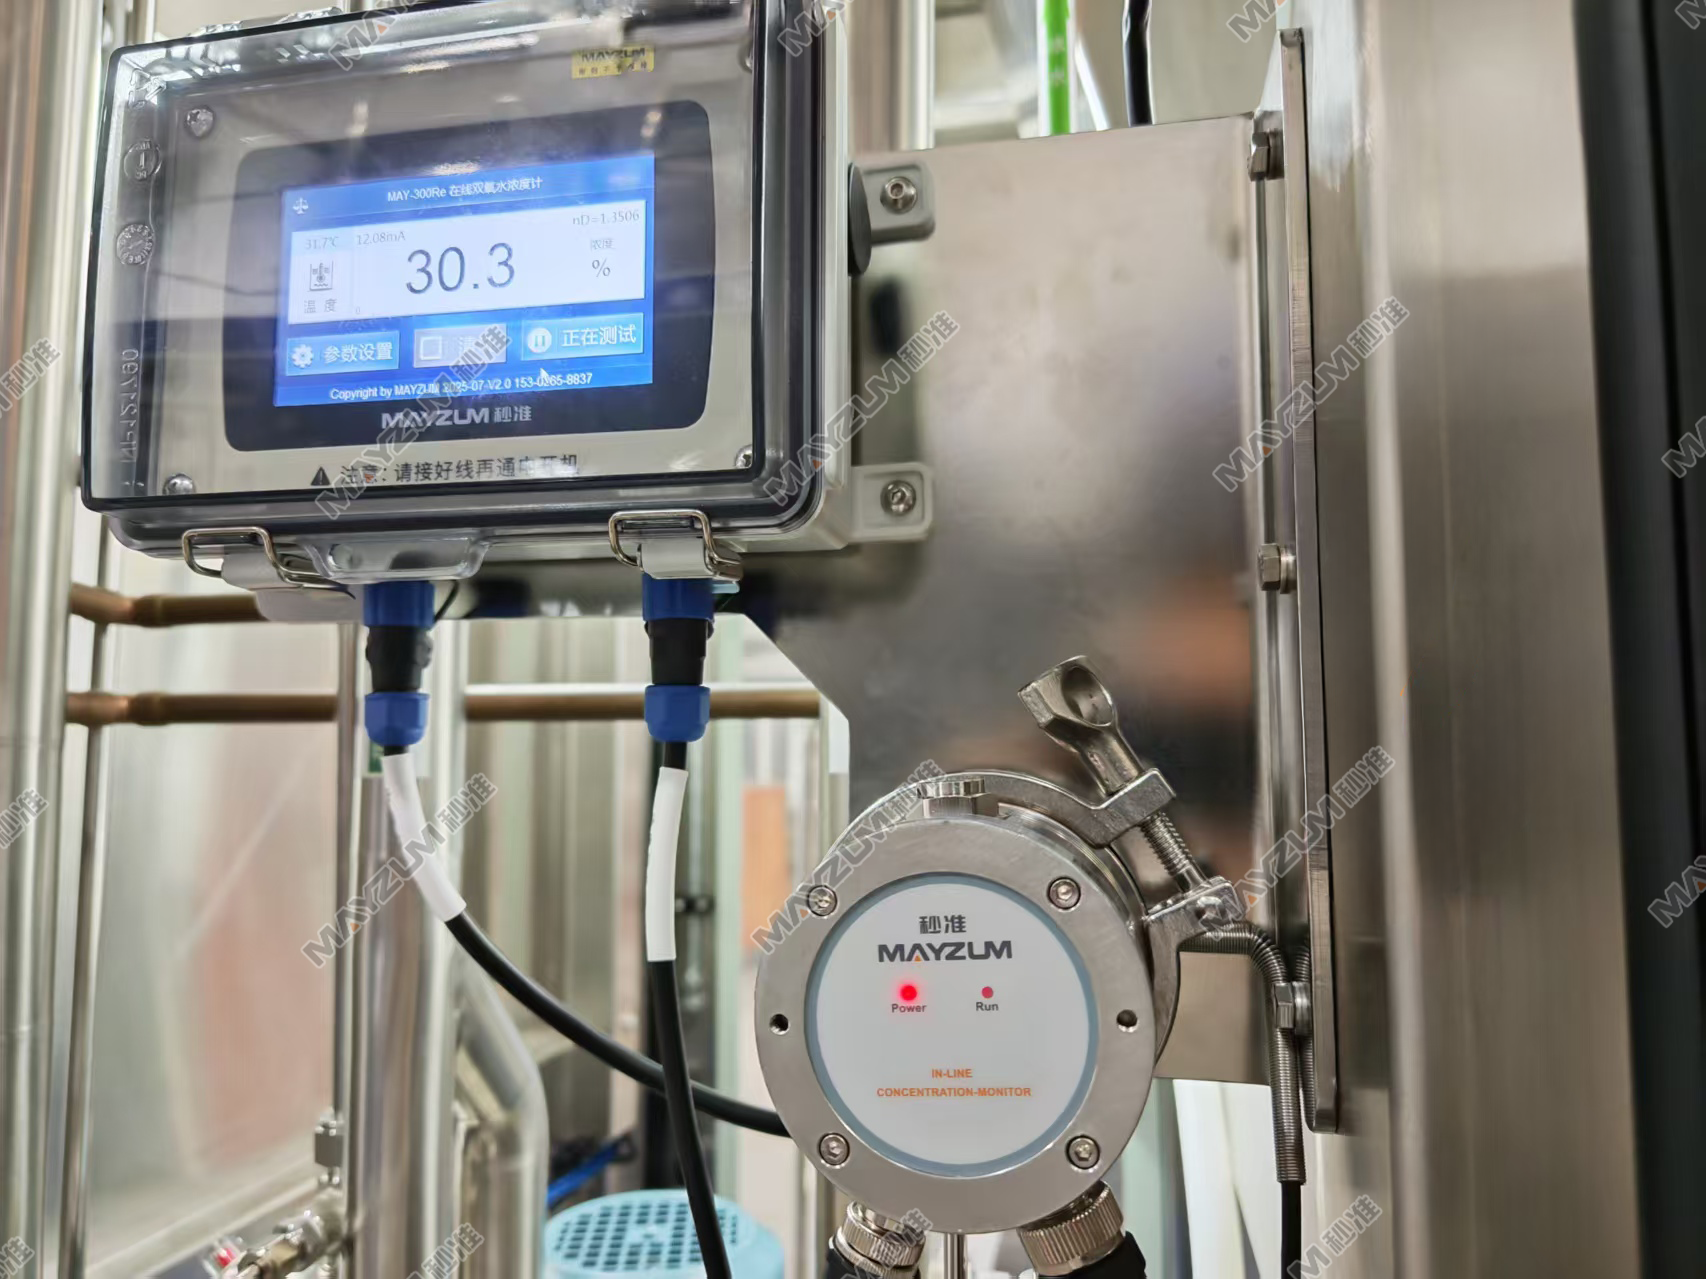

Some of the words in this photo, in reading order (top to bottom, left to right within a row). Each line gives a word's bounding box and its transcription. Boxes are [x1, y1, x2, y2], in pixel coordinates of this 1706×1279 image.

[387, 186, 447, 202] MAY-300Re
[356, 231, 406, 246] 12.08mA
[406, 242, 515, 295] 30.3
[591, 257, 611, 278] %
[562, 323, 636, 348] 正在测试
[324, 341, 393, 364] 参数设置
[330, 387, 378, 401] Copyright
[380, 386, 392, 398] by
[381, 407, 490, 430] MAYZUM
[919, 915, 967, 934] 秒准
[878, 940, 1013, 962] MAYZUM
[891, 1003, 927, 1013] Power
[975, 1001, 999, 1011] Run
[931, 1068, 973, 1079] IN-LINE
[876, 1087, 1032, 1098] CONCENTRATION-MONITOR
